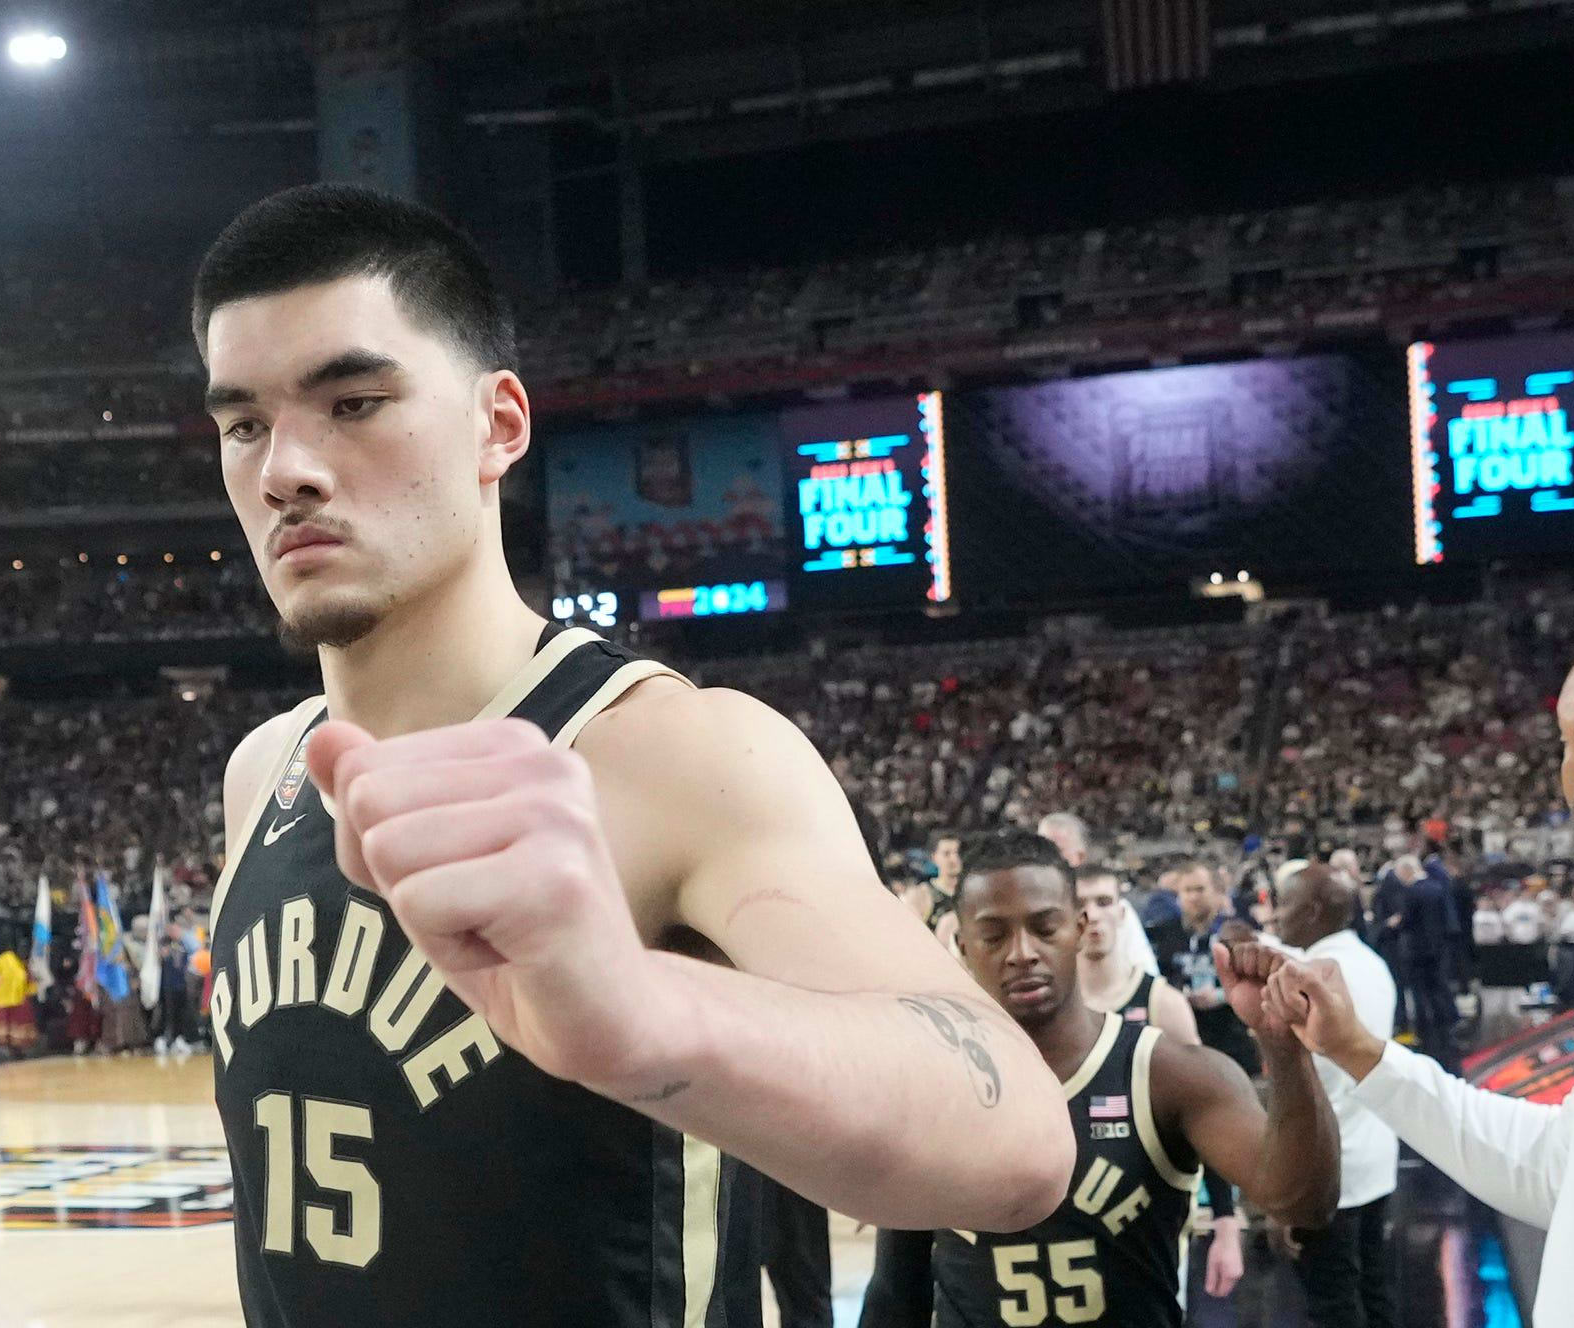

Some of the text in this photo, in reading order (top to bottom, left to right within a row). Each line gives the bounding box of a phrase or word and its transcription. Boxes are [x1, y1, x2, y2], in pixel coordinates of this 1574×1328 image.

[798, 469, 913, 515] FINAL
[1453, 450, 1574, 494] FOUR
[804, 507, 909, 549] FOUR
[210, 895, 503, 1112] PURDUE
[254, 1089, 383, 1270] 15
[992, 1239, 1107, 1328] 55
